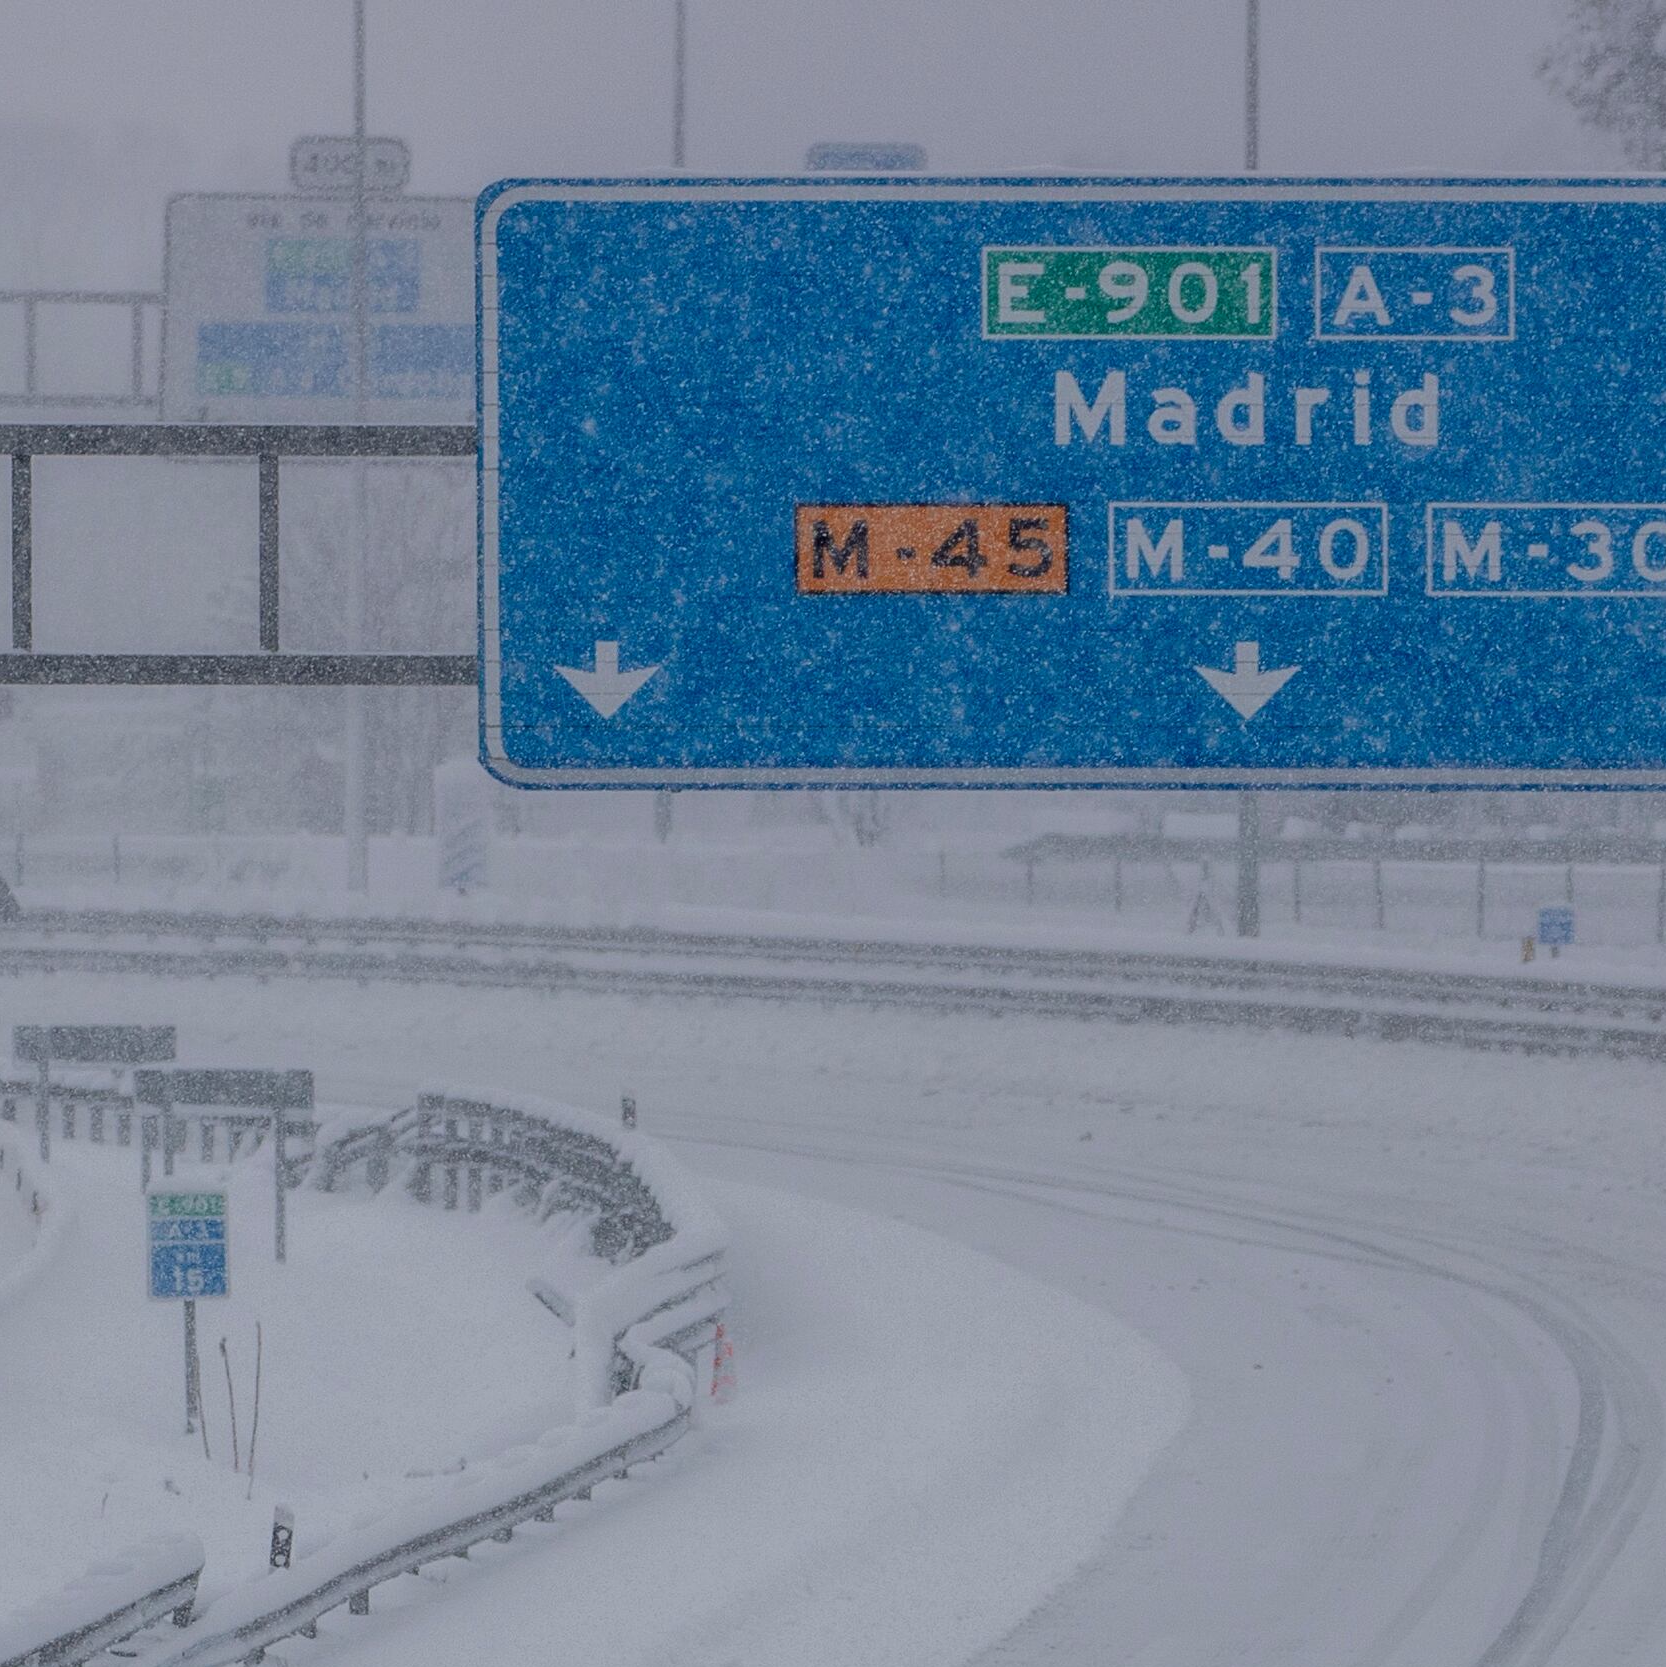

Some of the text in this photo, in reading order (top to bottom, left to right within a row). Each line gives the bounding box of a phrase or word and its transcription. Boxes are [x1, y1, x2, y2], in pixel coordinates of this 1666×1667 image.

[996, 262, 1498, 328] E-901 A-3
[1052, 371, 1442, 447] Madrid
[810, 519, 1058, 581] M-45
[1125, 516, 1375, 581] M-40
[173, 1267, 204, 1292] 15
